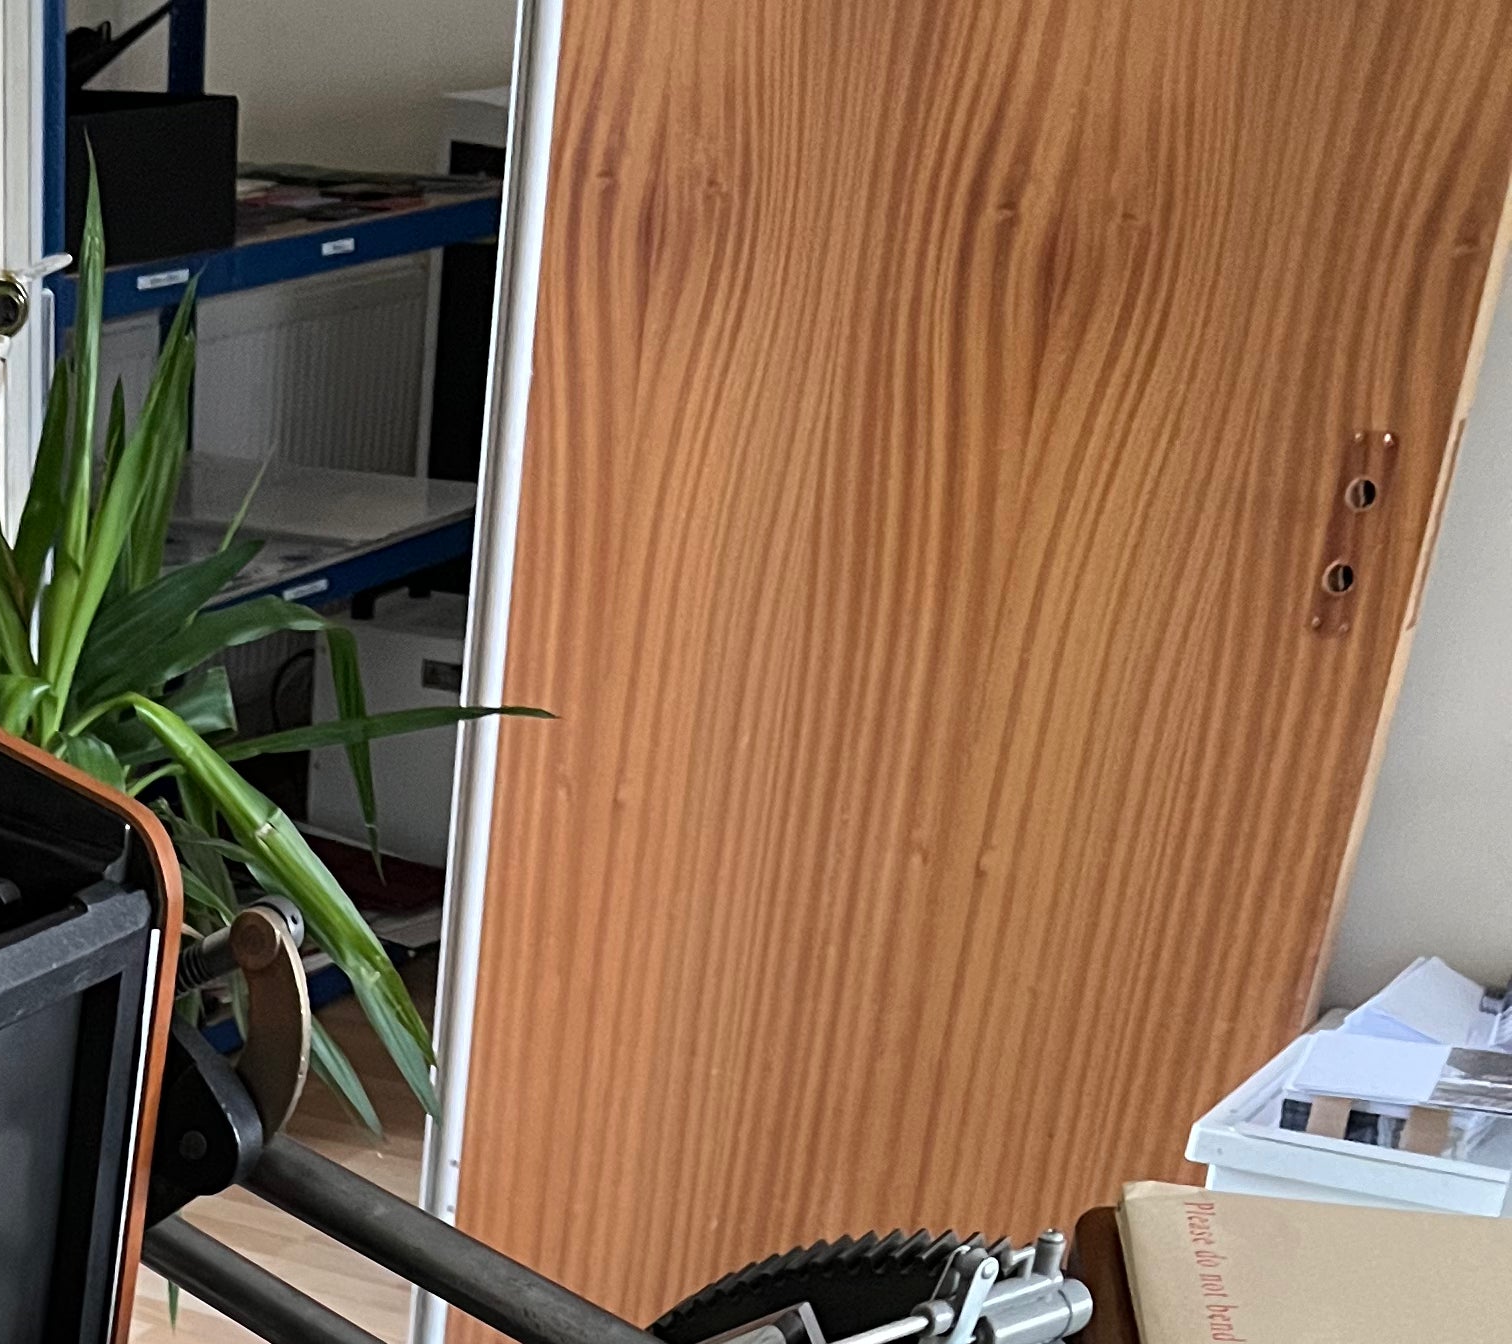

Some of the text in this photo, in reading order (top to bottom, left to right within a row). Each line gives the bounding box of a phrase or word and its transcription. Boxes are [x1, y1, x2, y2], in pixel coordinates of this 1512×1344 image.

[1184, 1202, 1247, 1342] Please do not bend
